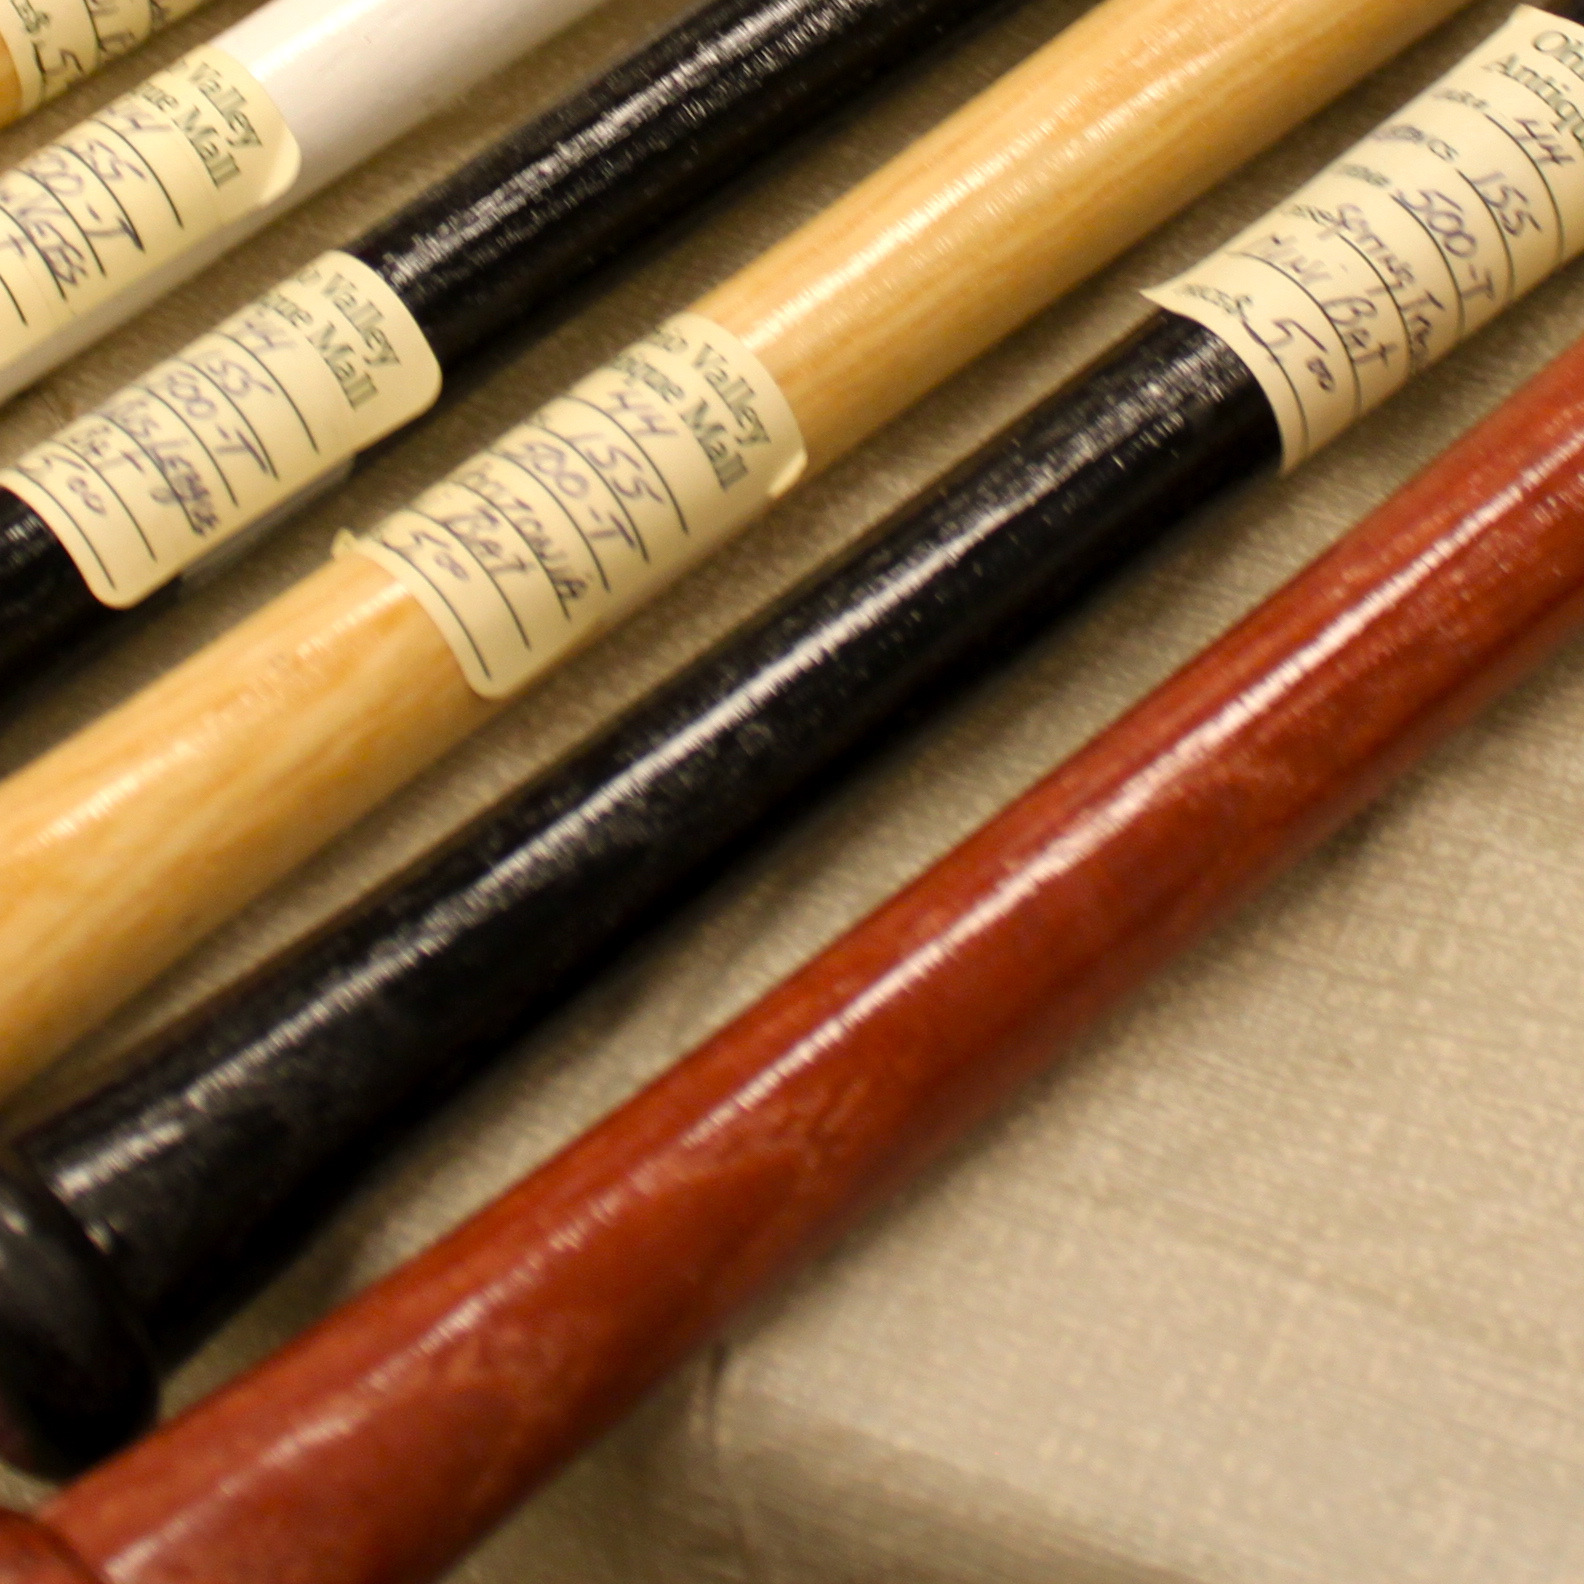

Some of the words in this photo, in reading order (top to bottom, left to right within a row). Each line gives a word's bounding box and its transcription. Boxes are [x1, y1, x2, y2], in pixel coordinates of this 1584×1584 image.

[171, 104, 242, 188] Mall
[188, 62, 264, 151] Valley
[1513, 117, 1574, 168] 44
[1394, 183, 1495, 300] 500-T
[1464, 167, 1541, 239] 155
[321, 272, 400, 366] Valley
[307, 321, 379, 411] Mall
[692, 342, 771, 447] Valley
[605, 390, 679, 437] 44
[679, 395, 749, 492] Mall
[566, 431, 665, 506] 155
